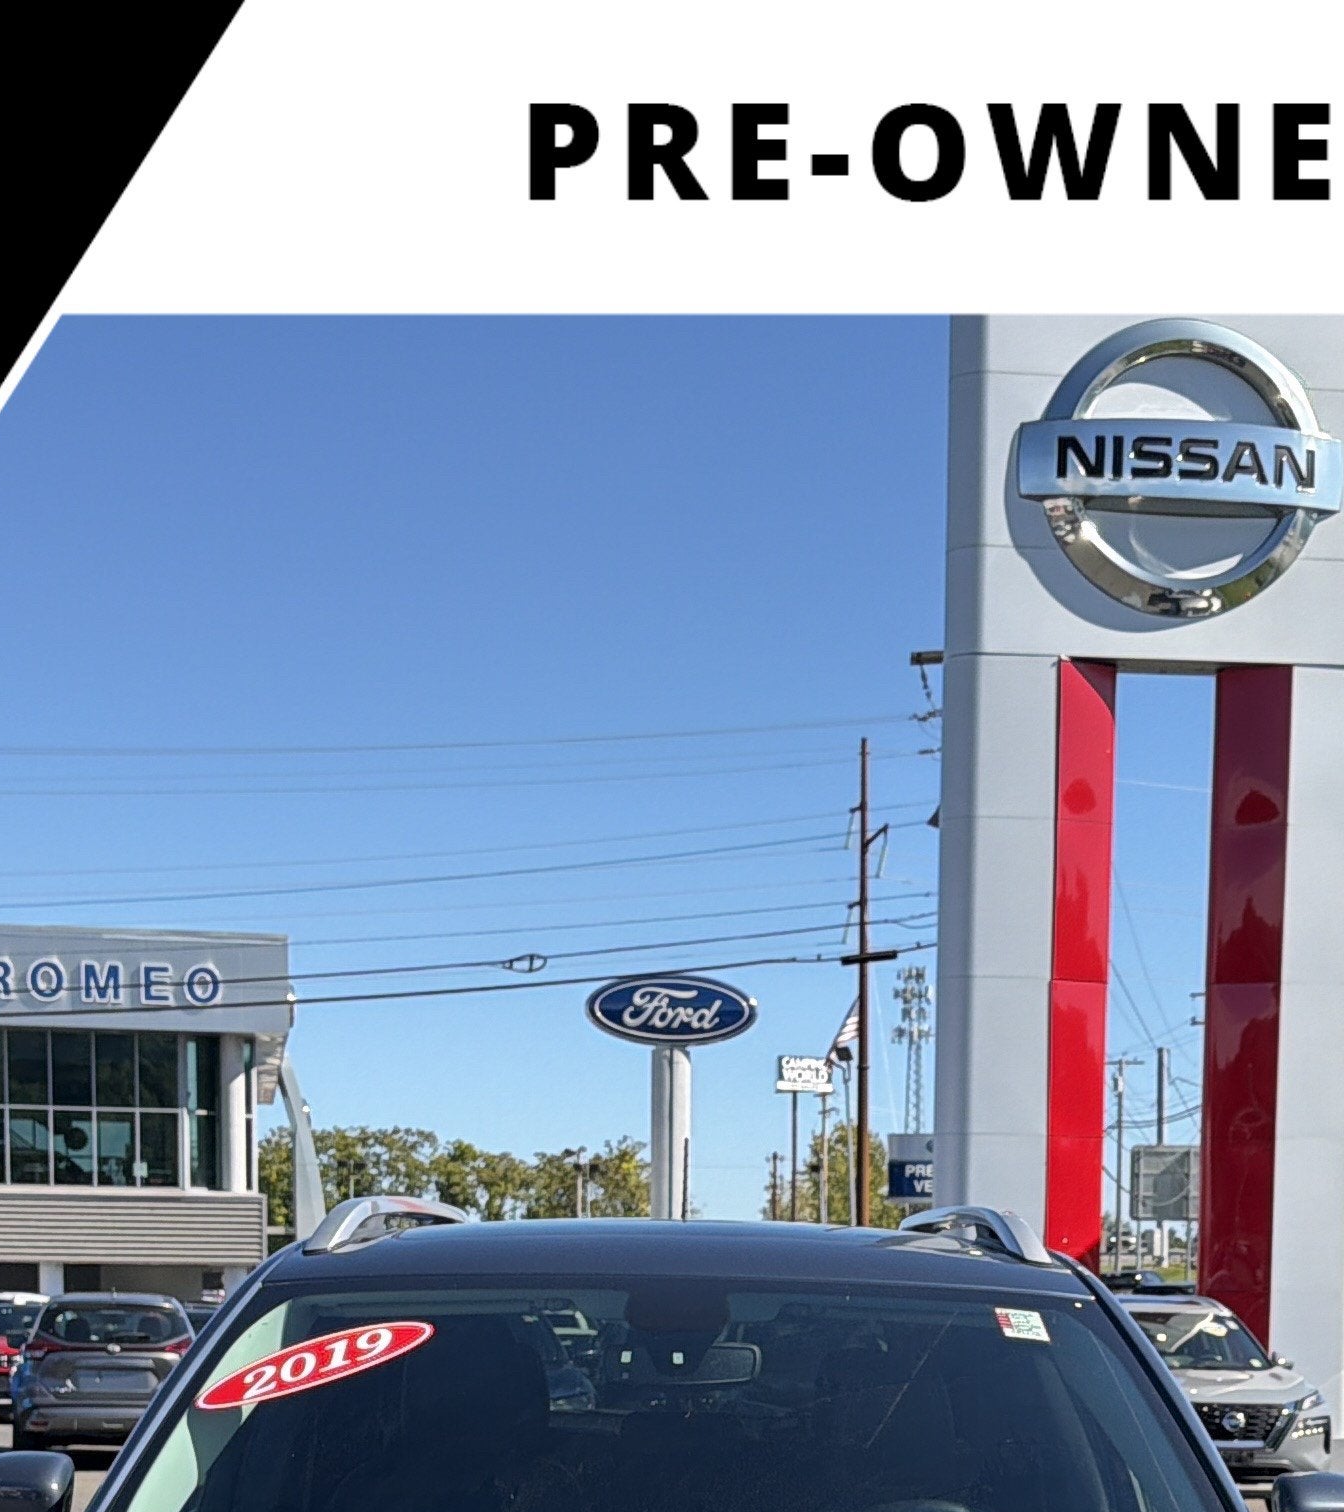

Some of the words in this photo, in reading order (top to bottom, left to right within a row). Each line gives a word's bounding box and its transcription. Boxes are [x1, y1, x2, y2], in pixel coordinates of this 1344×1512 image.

[1056, 435, 1317, 492] NISSAN
[622, 986, 723, 1030] Ford
[782, 1069, 829, 1083] WORLD
[243, 1327, 393, 1401] 2019
